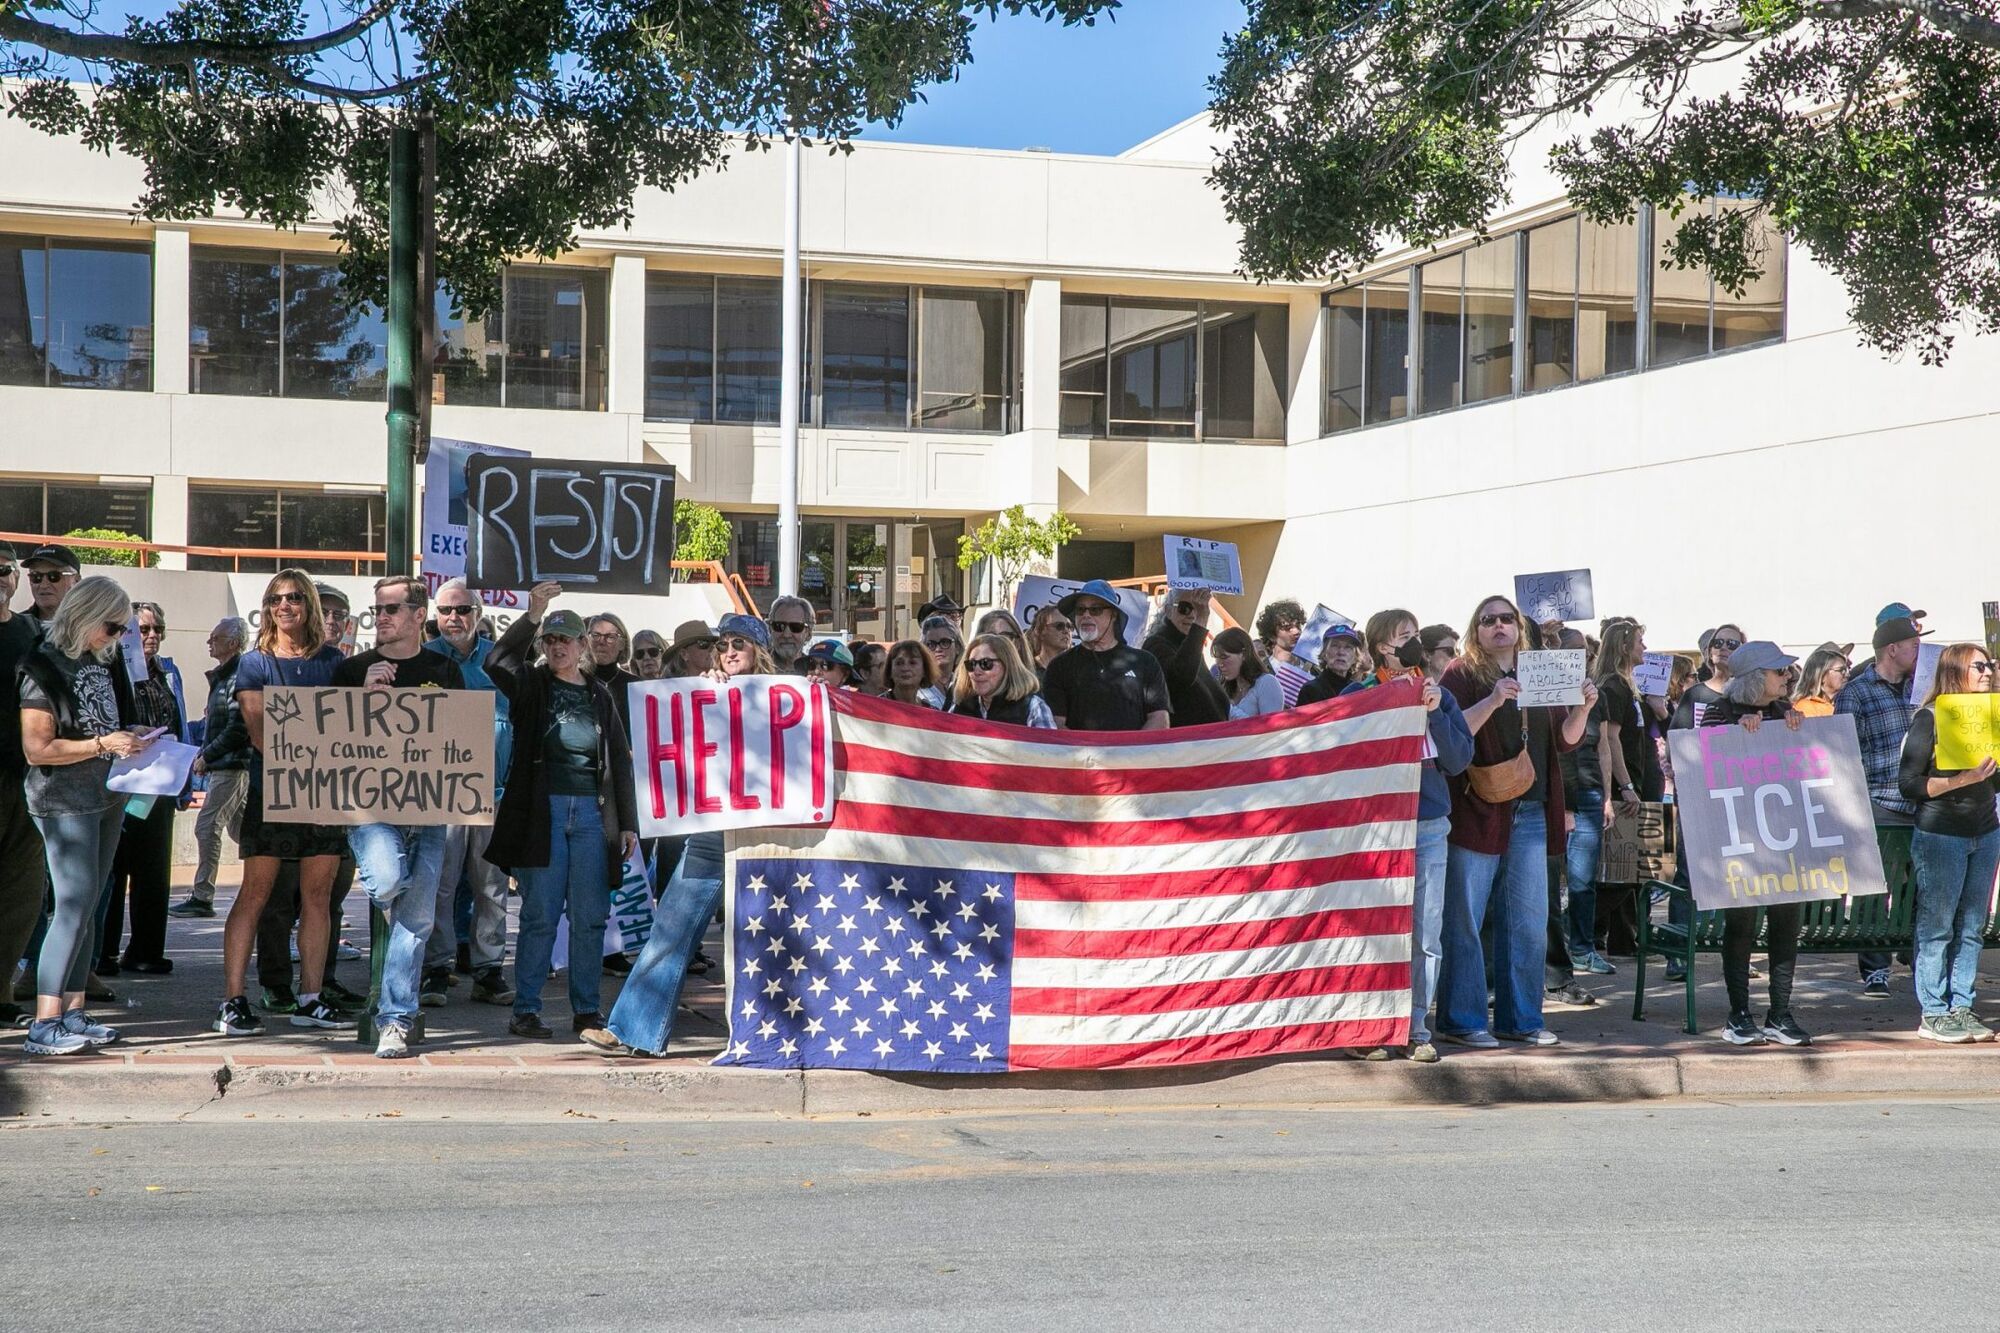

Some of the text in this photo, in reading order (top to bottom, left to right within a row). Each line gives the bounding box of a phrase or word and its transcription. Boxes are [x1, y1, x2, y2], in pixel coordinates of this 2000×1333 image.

[478, 467, 674, 584] RESIST
[423, 572, 518, 606] TH EDS
[1170, 580, 1240, 593] GOOD WOMAN
[1522, 577, 1545, 594] ICE
[1519, 652, 1580, 661] THEY SHOWED
[1548, 662, 1568, 671] THEY
[1569, 663, 1582, 671] ARE
[1528, 674, 1580, 687] ABOLISH
[1532, 691, 1564, 703] ICE
[315, 689, 448, 737] FIRST
[1951, 705, 1982, 720] STOP
[1960, 722, 1988, 734] STOP
[271, 732, 473, 768] they came for the
[645, 683, 825, 821] HELP!
[1699, 727, 1829, 789] Freeze
[1710, 778, 1844, 857] ICE
[1726, 853, 1848, 899] funding
